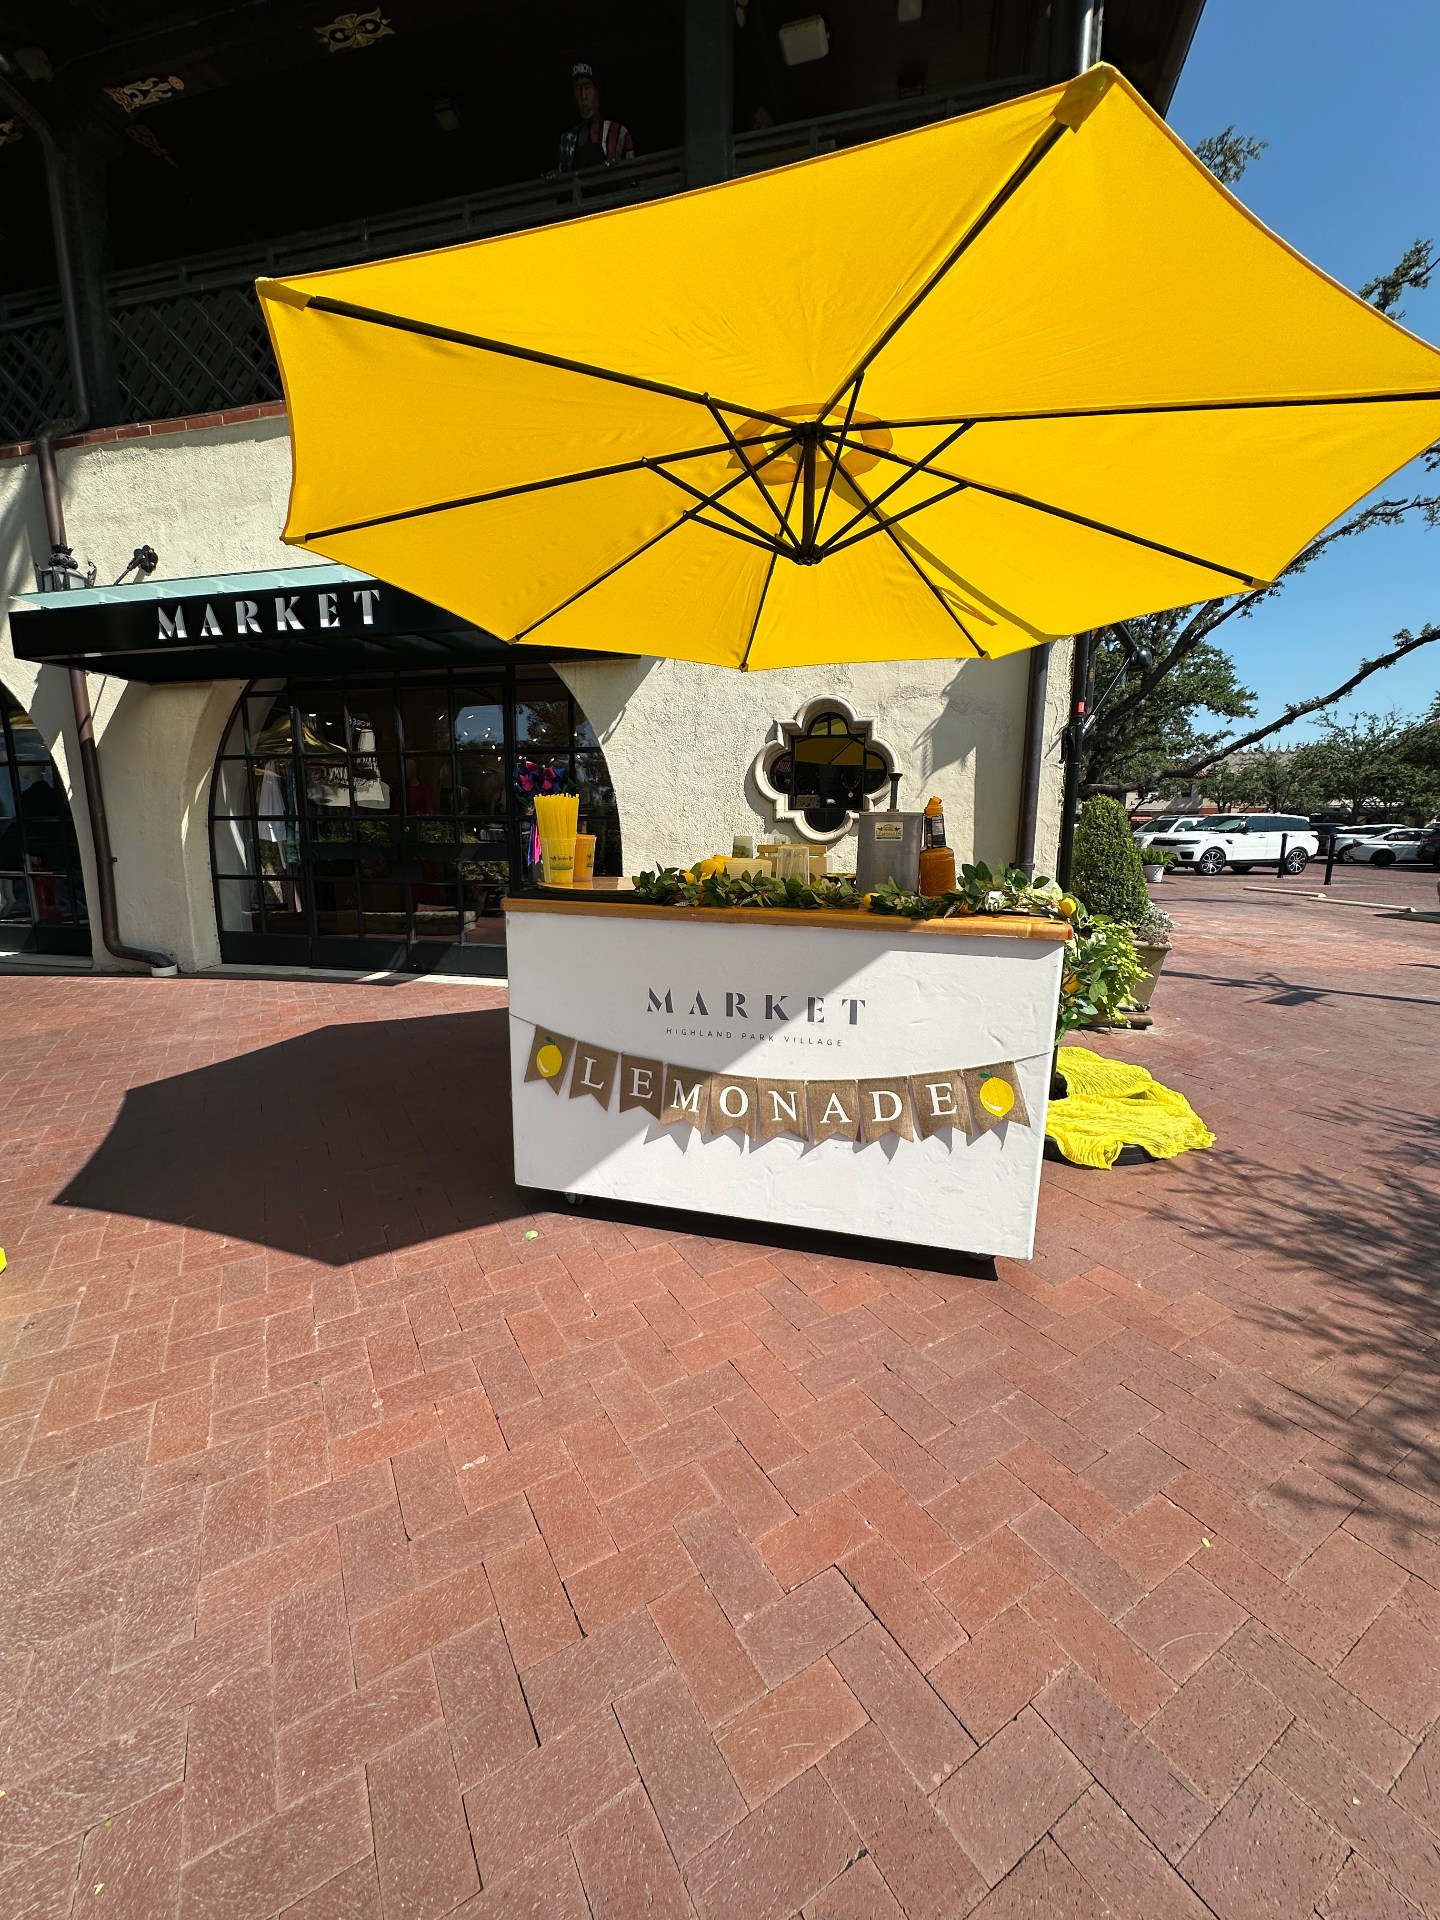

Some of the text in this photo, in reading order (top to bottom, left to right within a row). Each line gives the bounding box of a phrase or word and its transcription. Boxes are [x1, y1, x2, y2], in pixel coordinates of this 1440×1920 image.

[158, 589, 380, 640] MARKET
[647, 987, 866, 1025] MARKET
[666, 1027, 843, 1047] HIGHLAND PARK VILLAGE
[580, 1057, 958, 1124] LEMONADE
